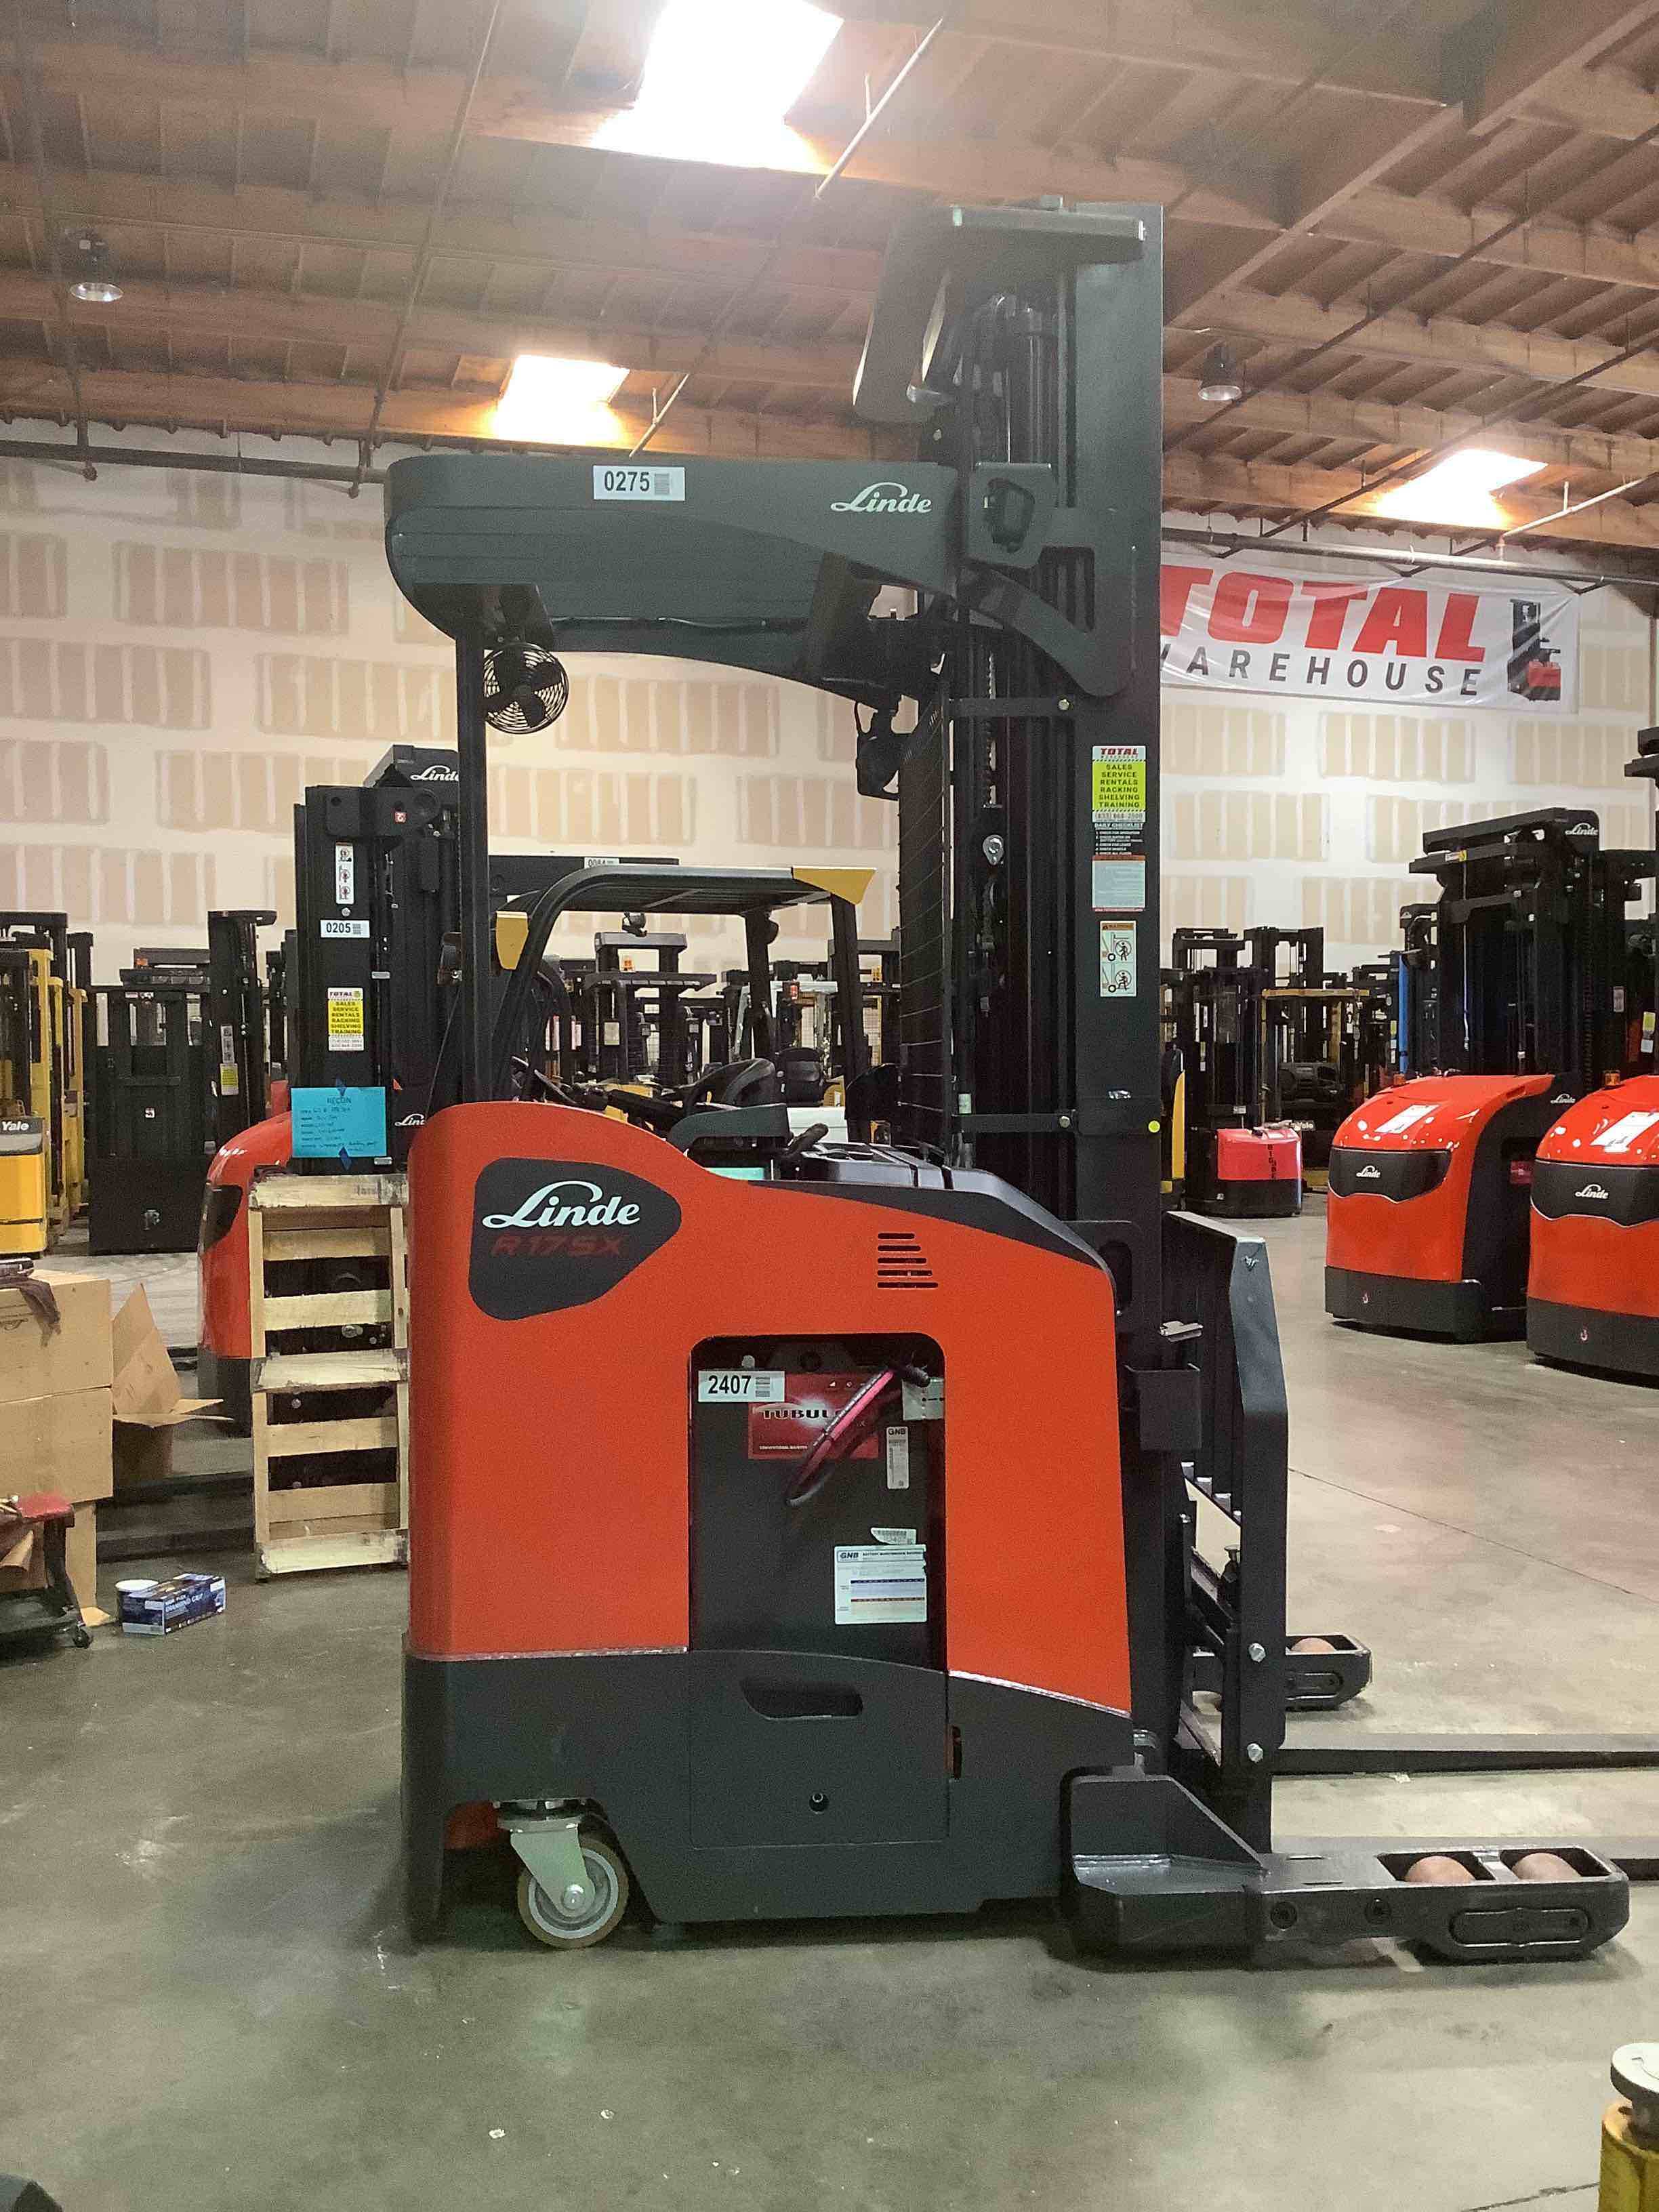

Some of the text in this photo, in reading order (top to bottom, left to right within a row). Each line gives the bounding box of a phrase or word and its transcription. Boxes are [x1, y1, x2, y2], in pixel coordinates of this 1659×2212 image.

[604, 471, 651, 492] 0275
[830, 482, 933, 513] Linde
[1160, 564, 1486, 662] TOTAL
[1565, 822, 1598, 836] Linde
[326, 922, 351, 933] 0205
[2, 1121, 29, 1131] Yale
[1356, 1165, 1380, 1178] Linde
[1575, 1184, 1609, 1199] Linde
[482, 1181, 640, 1229] Linde
[708, 1375, 752, 1394] 2407
[760, 1409, 831, 1420] TUBUL
